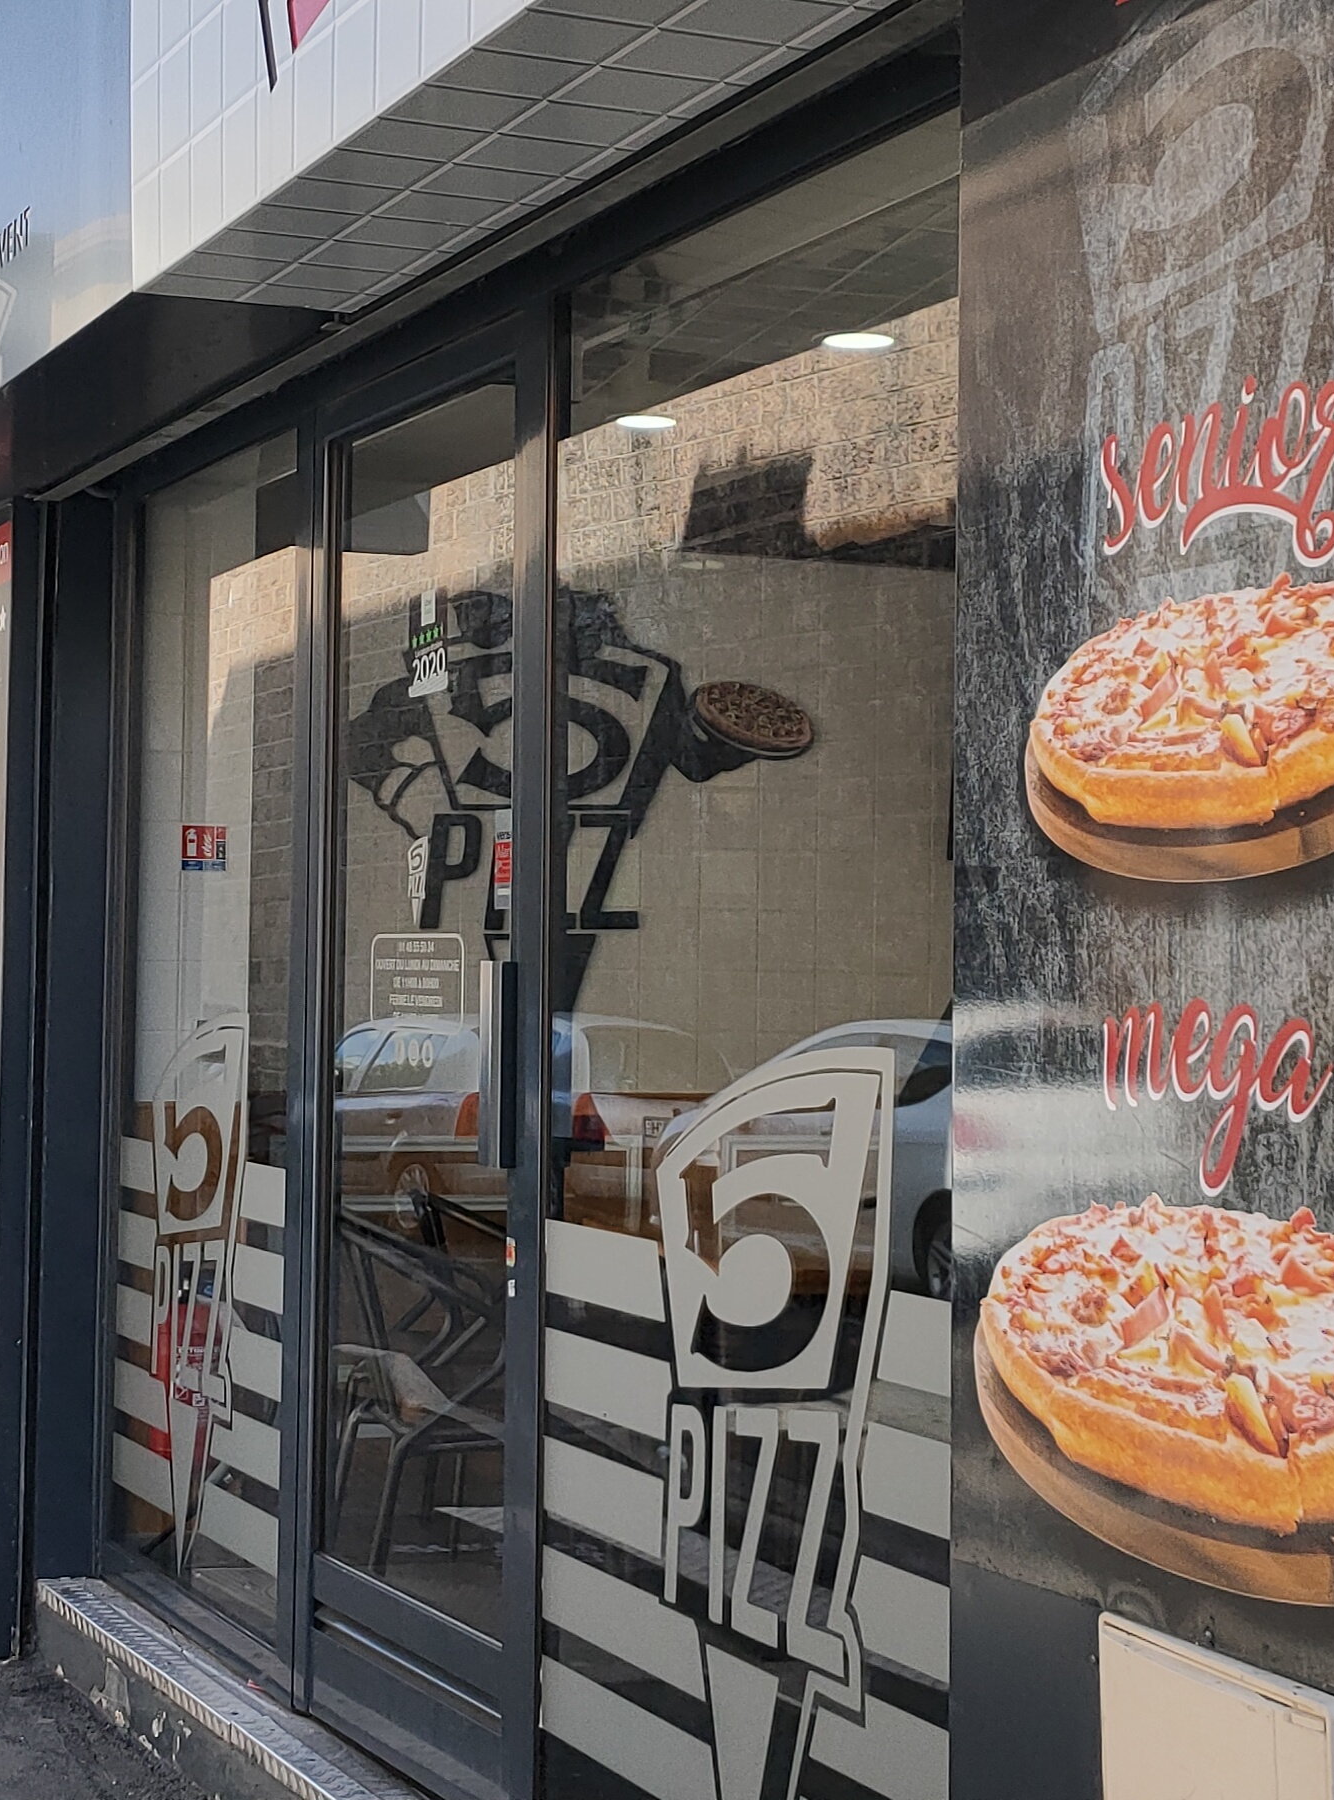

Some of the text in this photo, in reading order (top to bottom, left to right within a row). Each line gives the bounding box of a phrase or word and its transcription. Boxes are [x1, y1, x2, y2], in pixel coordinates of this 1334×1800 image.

[412, 647, 446, 686] 2020
[165, 1044, 227, 1222] 5
[1103, 997, 1334, 1197] mega
[151, 1239, 226, 1404] PIZZ
[679, 1096, 837, 1373] 5
[663, 1402, 849, 1681] PIZZ
